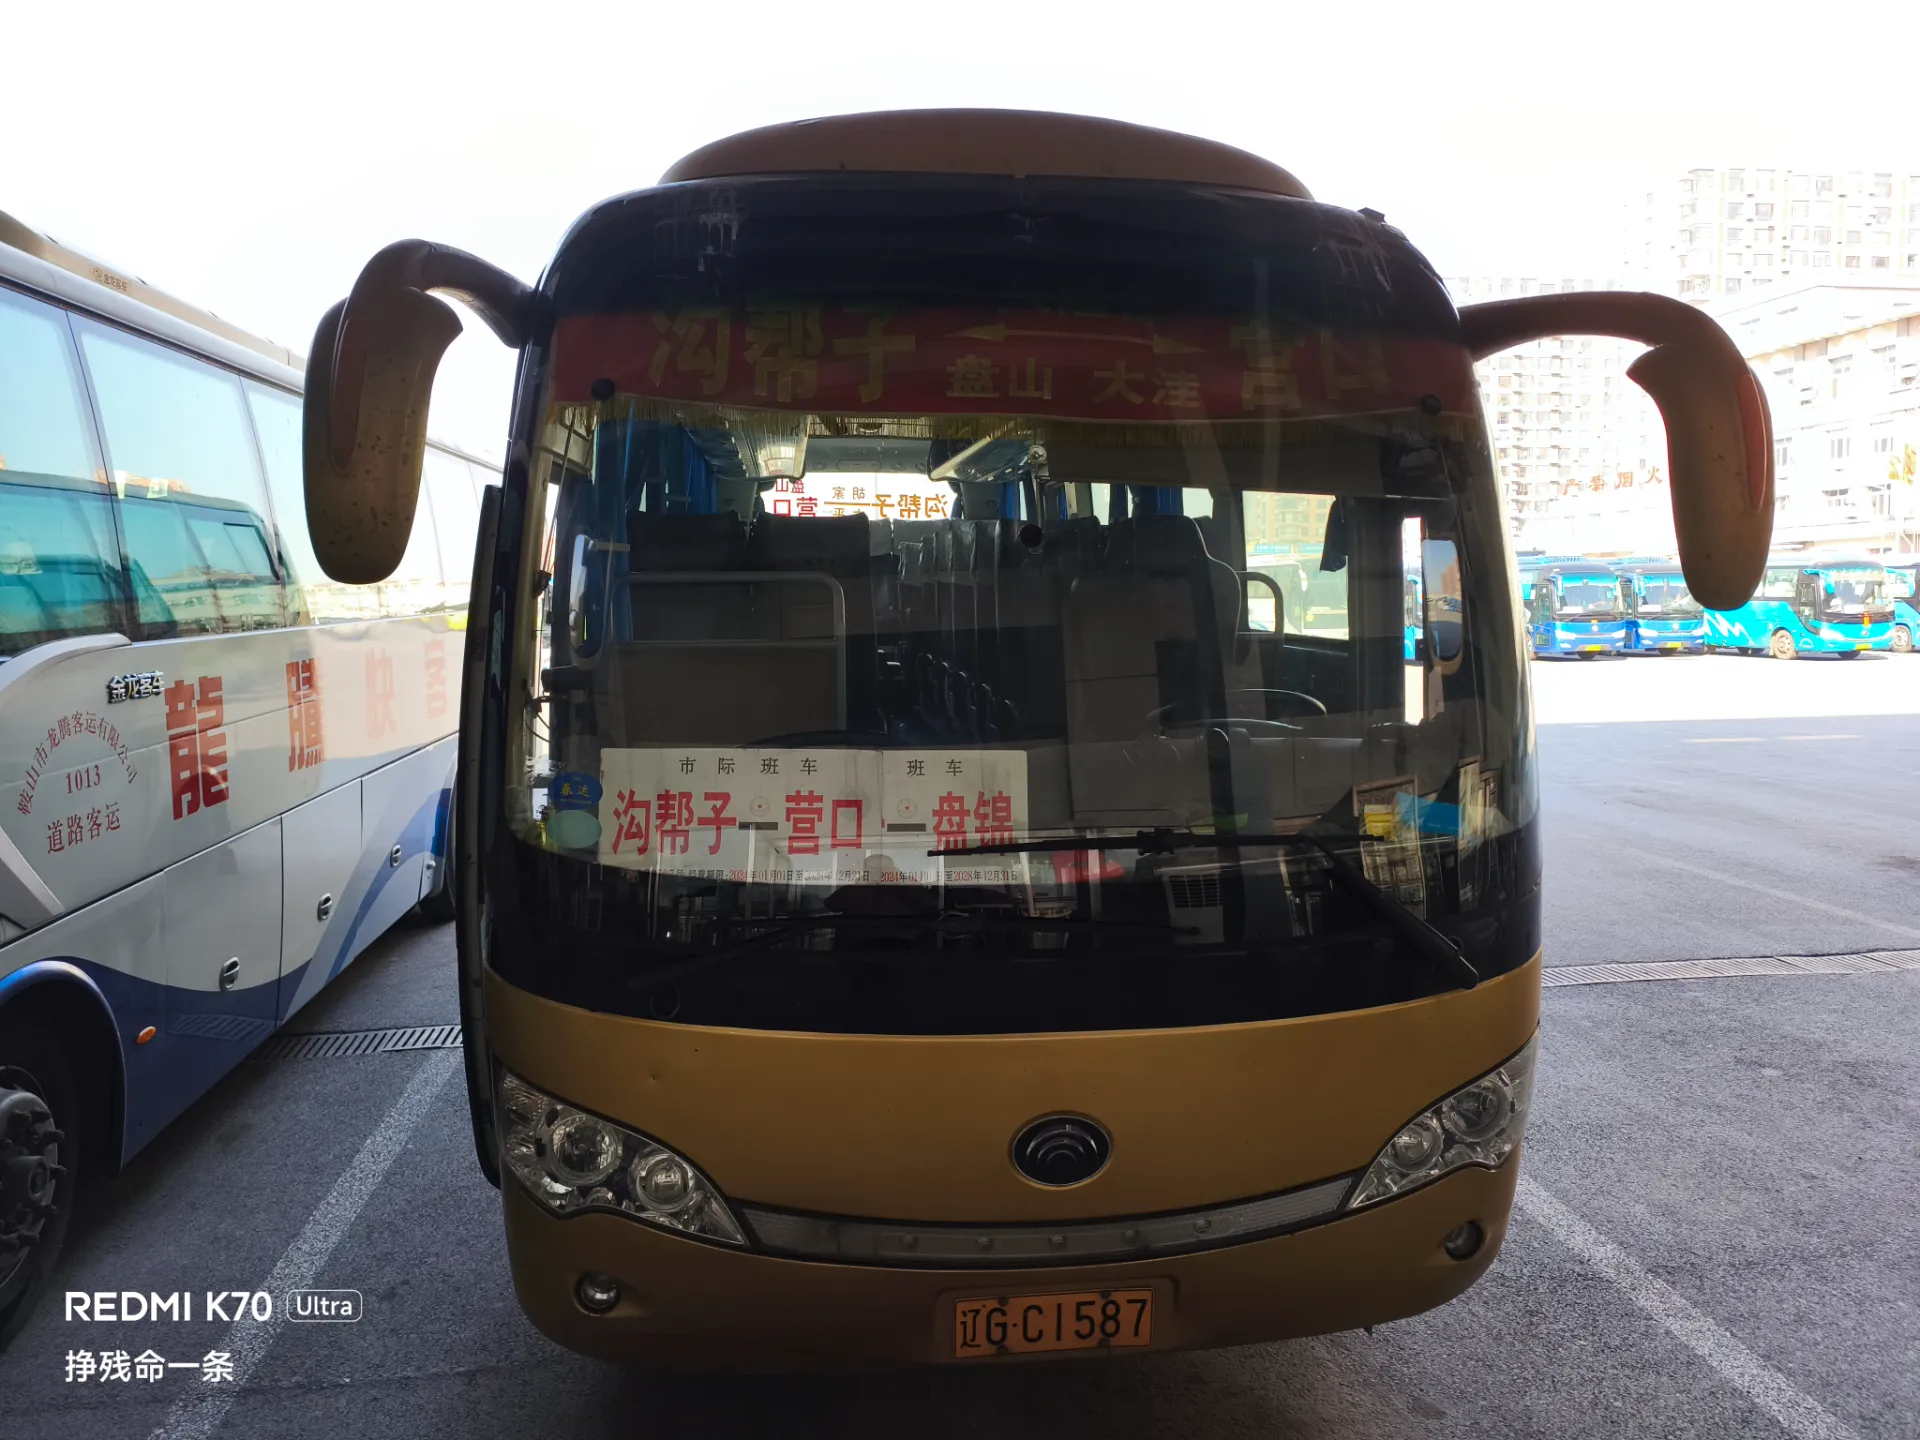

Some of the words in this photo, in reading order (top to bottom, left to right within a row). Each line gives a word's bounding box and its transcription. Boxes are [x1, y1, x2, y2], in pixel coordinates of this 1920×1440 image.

[648, 291, 916, 404] 沟帮子
[945, 354, 1051, 400] 盘山
[1094, 360, 1200, 409] 大洼
[109, 671, 165, 703] 金龙客车
[17, 711, 137, 816] 鞍山市龙腾客运有限公司
[65, 765, 101, 794] 1013
[679, 756, 818, 776] 市际班车
[907, 757, 963, 778] 班车
[47, 802, 121, 854] 道路客运
